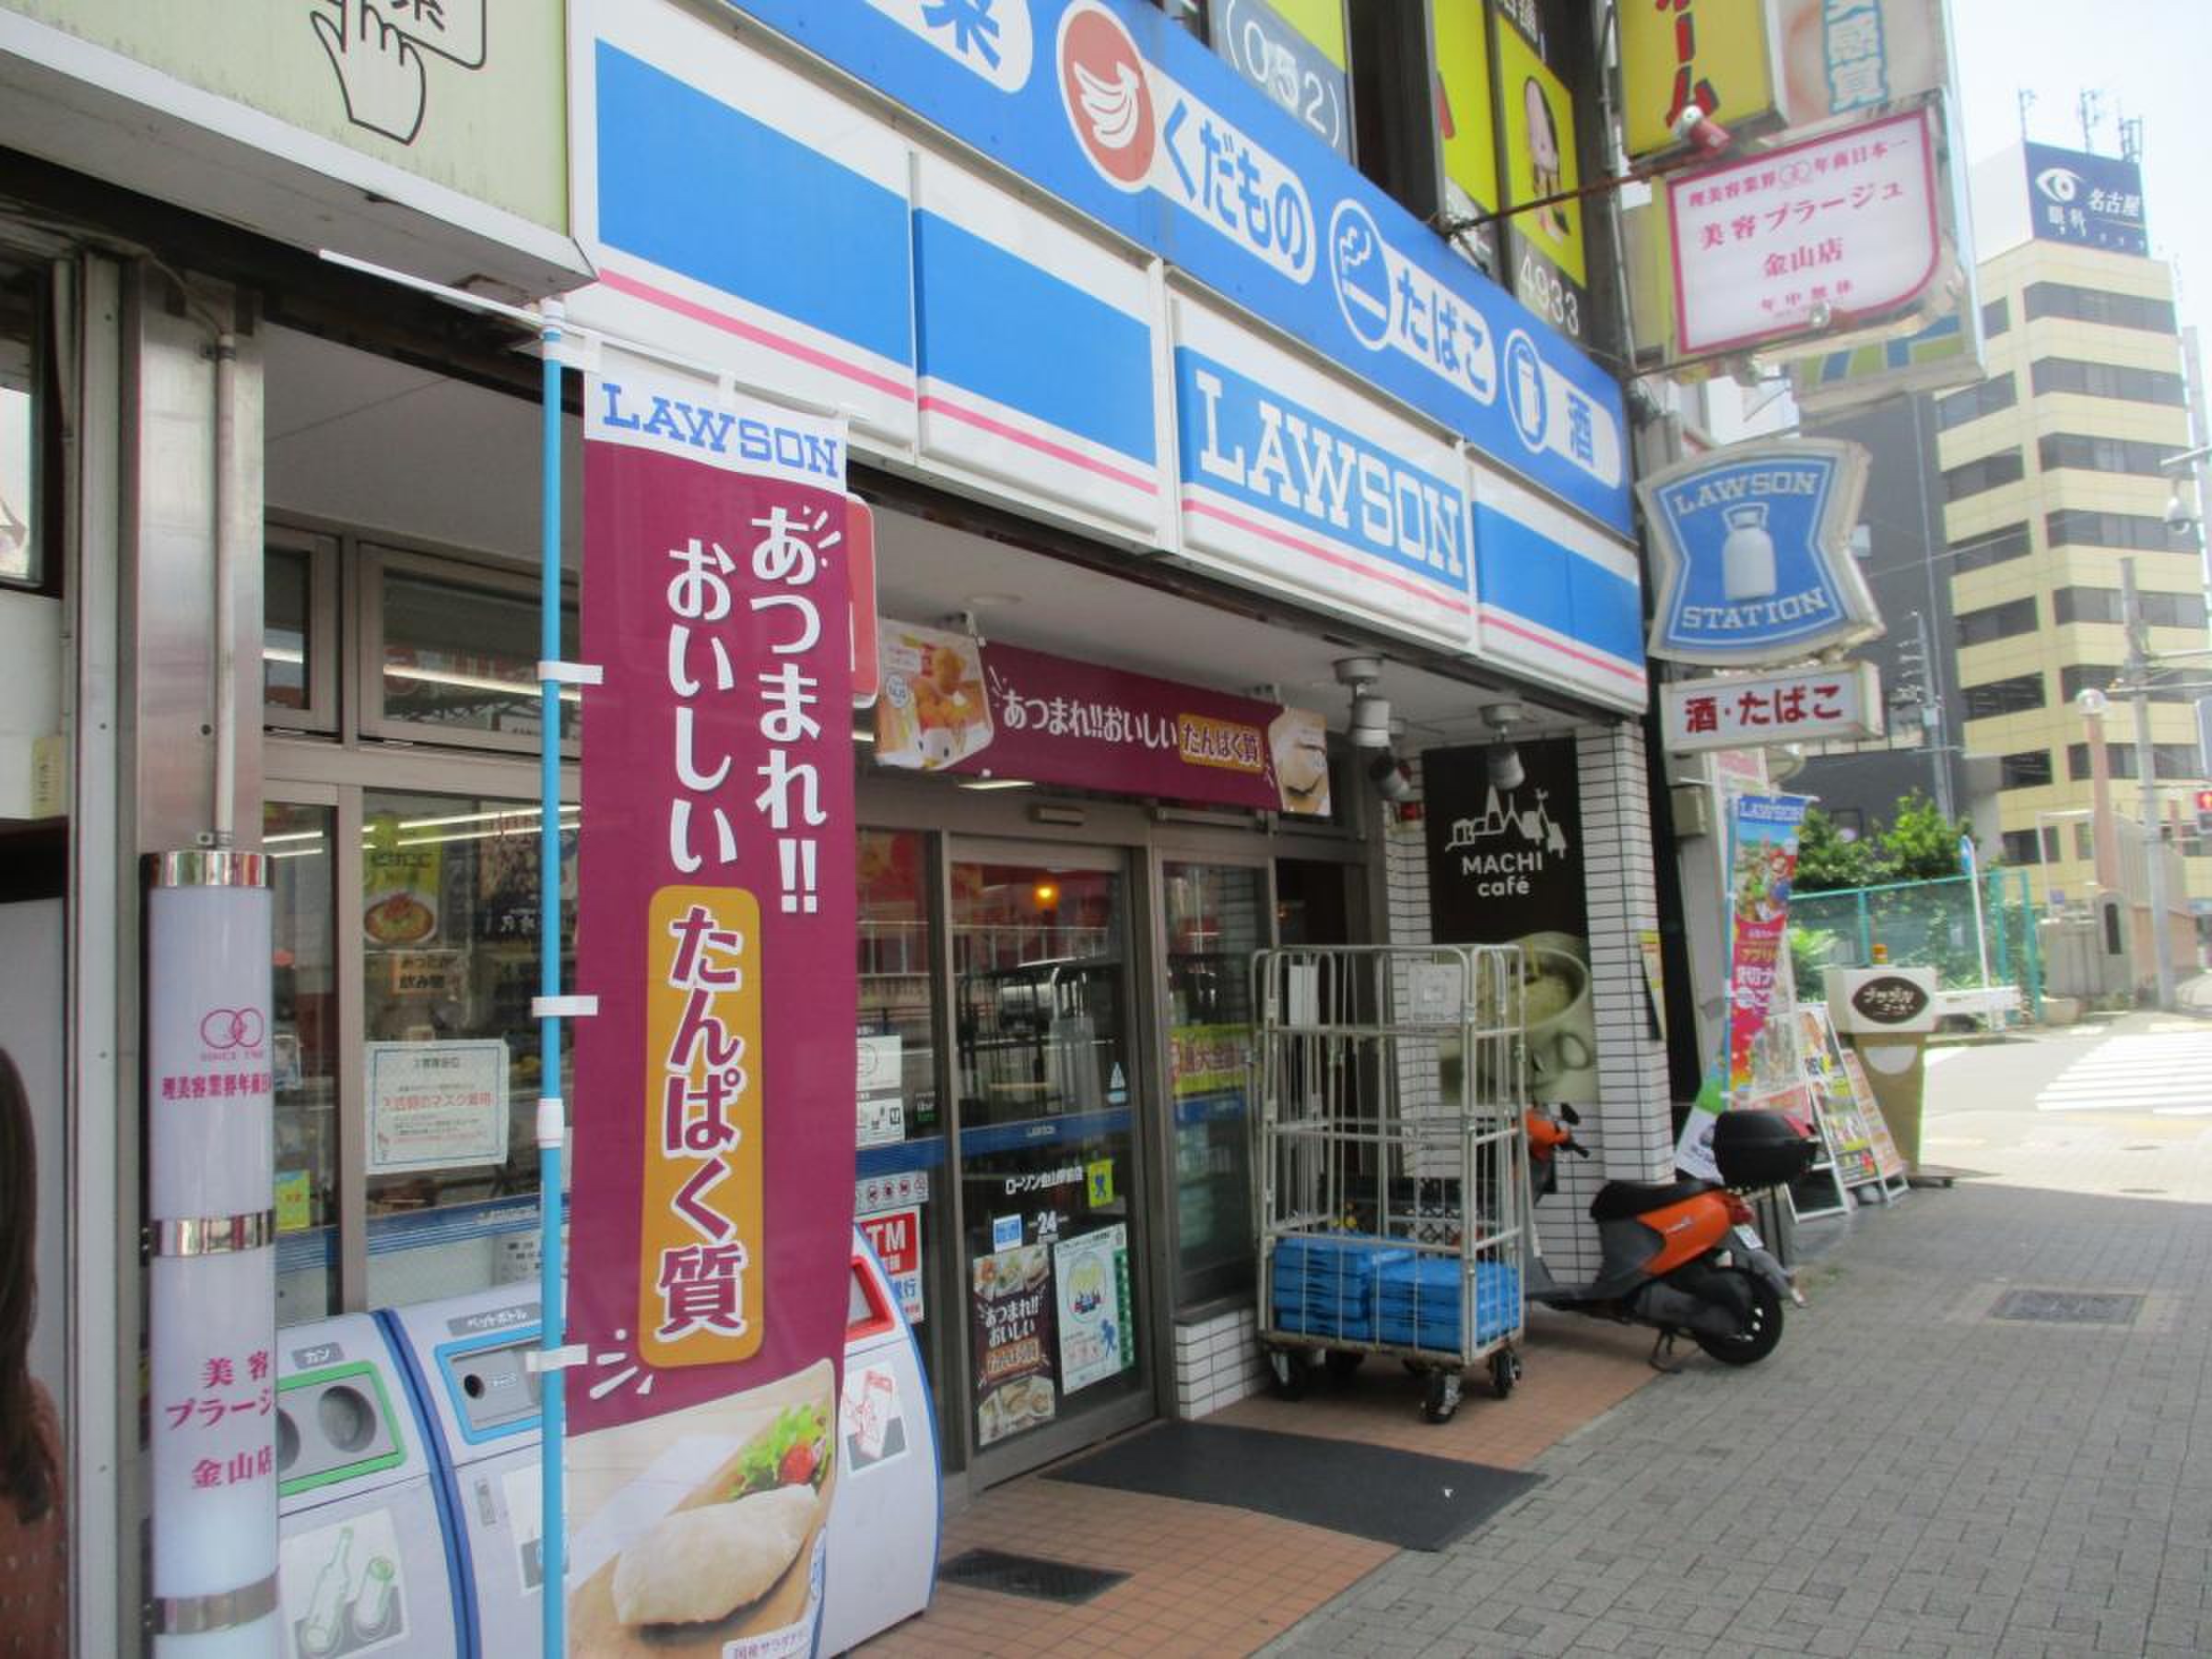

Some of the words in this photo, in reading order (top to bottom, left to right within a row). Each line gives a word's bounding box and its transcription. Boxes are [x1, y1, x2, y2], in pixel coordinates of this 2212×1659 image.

[1163, 99, 1307, 270] くだもの
[1764, 237, 1844, 277] 金山店
[1396, 267, 1488, 391] たばこ
[601, 382, 840, 479] LAWSON
[1566, 388, 1594, 465] 酒
[1194, 369, 1465, 579] LAWSON
[1673, 471, 1819, 515] LAWSON
[1680, 586, 1830, 630] STATION
[665, 537, 737, 874] おいしい
[749, 506, 827, 913] あつまれ!!
[1461, 851, 1544, 876] MACHI
[1477, 875, 1531, 898] café
[653, 904, 747, 1344] たんぱく質
[1037, 1210, 1058, 1234] 24
[303, 1347, 330, 1365] カン
